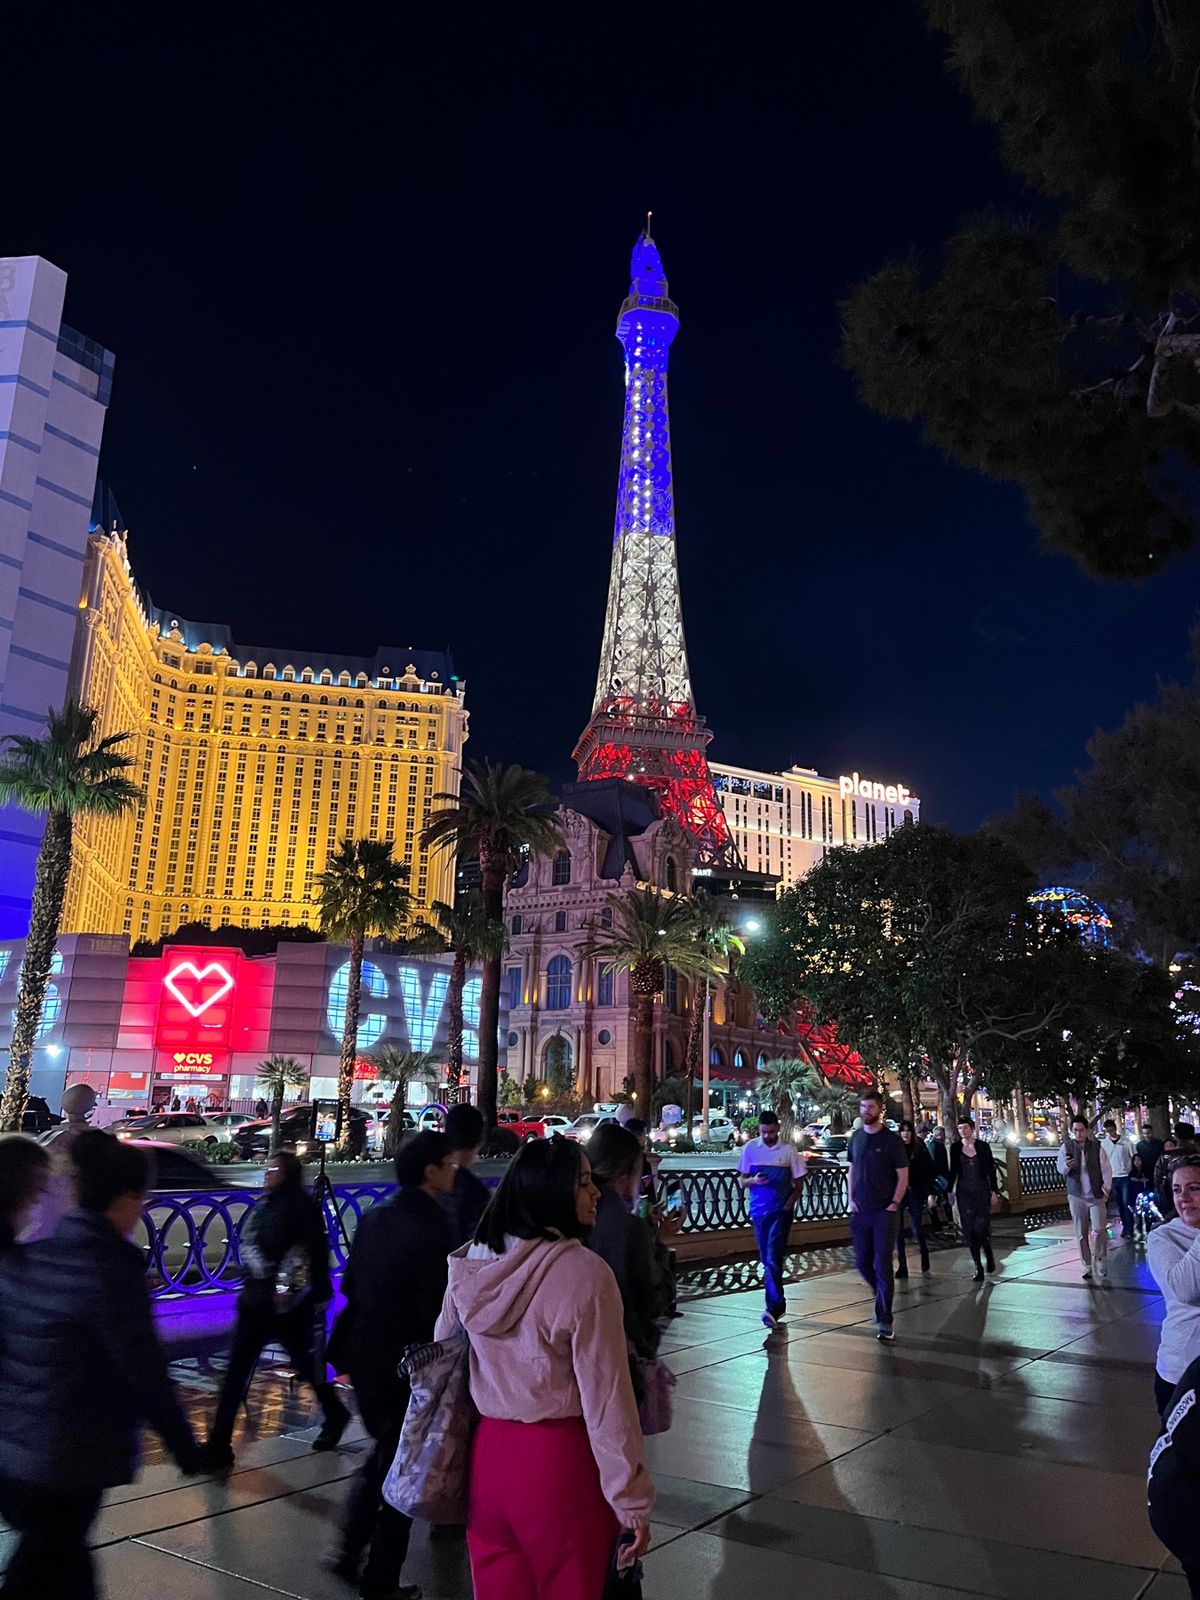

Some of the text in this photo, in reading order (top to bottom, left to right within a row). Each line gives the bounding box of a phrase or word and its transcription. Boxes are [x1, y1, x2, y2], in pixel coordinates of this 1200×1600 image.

[839, 772, 910, 806] planet
[186, 1053, 213, 1065] CVS
[174, 1064, 211, 1073] pharmacy
